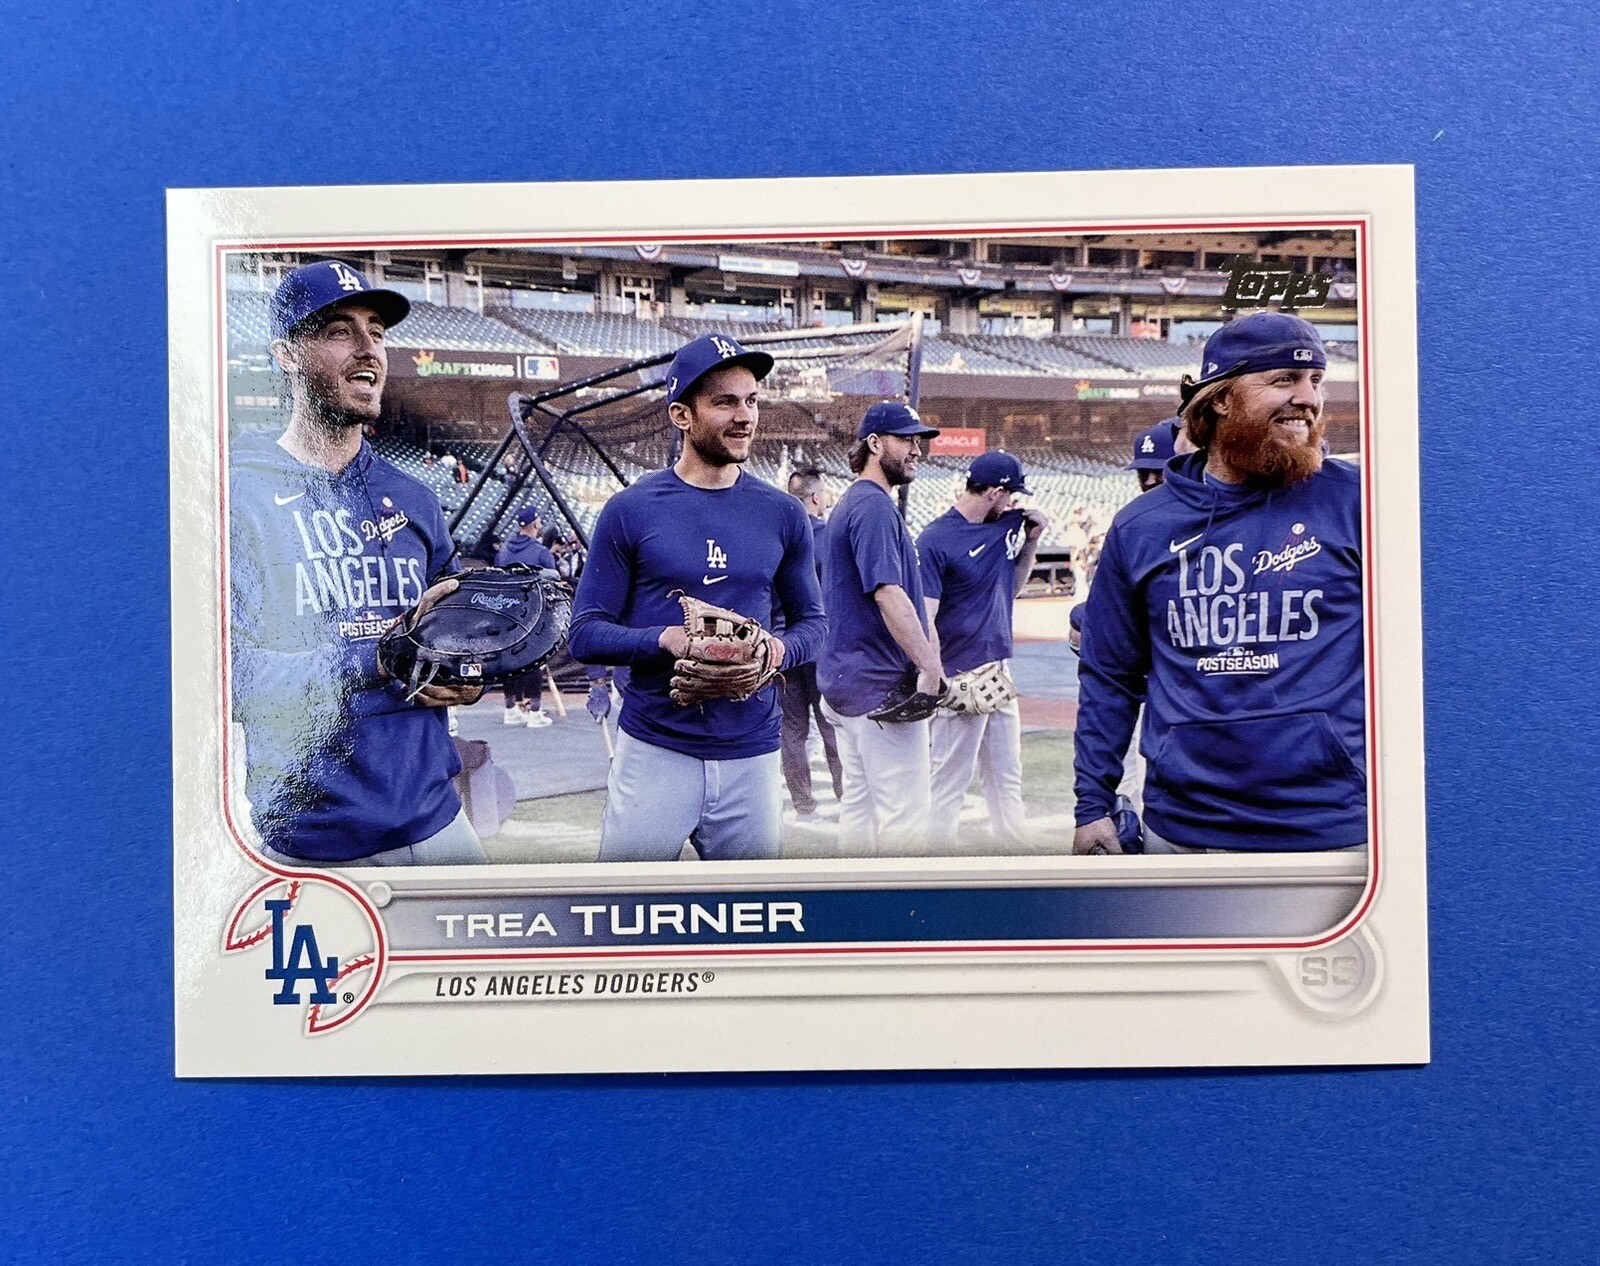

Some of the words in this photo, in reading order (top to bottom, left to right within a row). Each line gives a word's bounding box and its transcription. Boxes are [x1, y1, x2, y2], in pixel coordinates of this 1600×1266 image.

[329, 263, 364, 292] LA
[710, 336, 737, 359] LA
[293, 509, 364, 560] LOS
[706, 539, 727, 569] LA
[1178, 543, 1245, 598] LOS
[1252, 536, 1322, 575] Dodgers
[295, 556, 423, 616] ANGELES
[339, 617, 399, 637] POSTSEASO
[1167, 589, 1324, 649] ANGELES
[1196, 653, 1279, 671] POSTSEASON
[436, 913, 557, 938] TREA
[570, 902, 805, 936] TURNER
[264, 899, 339, 1005] LA
[436, 976, 477, 997] LOS
[485, 974, 585, 997] ANGELES
[1301, 956, 1358, 987] SS
